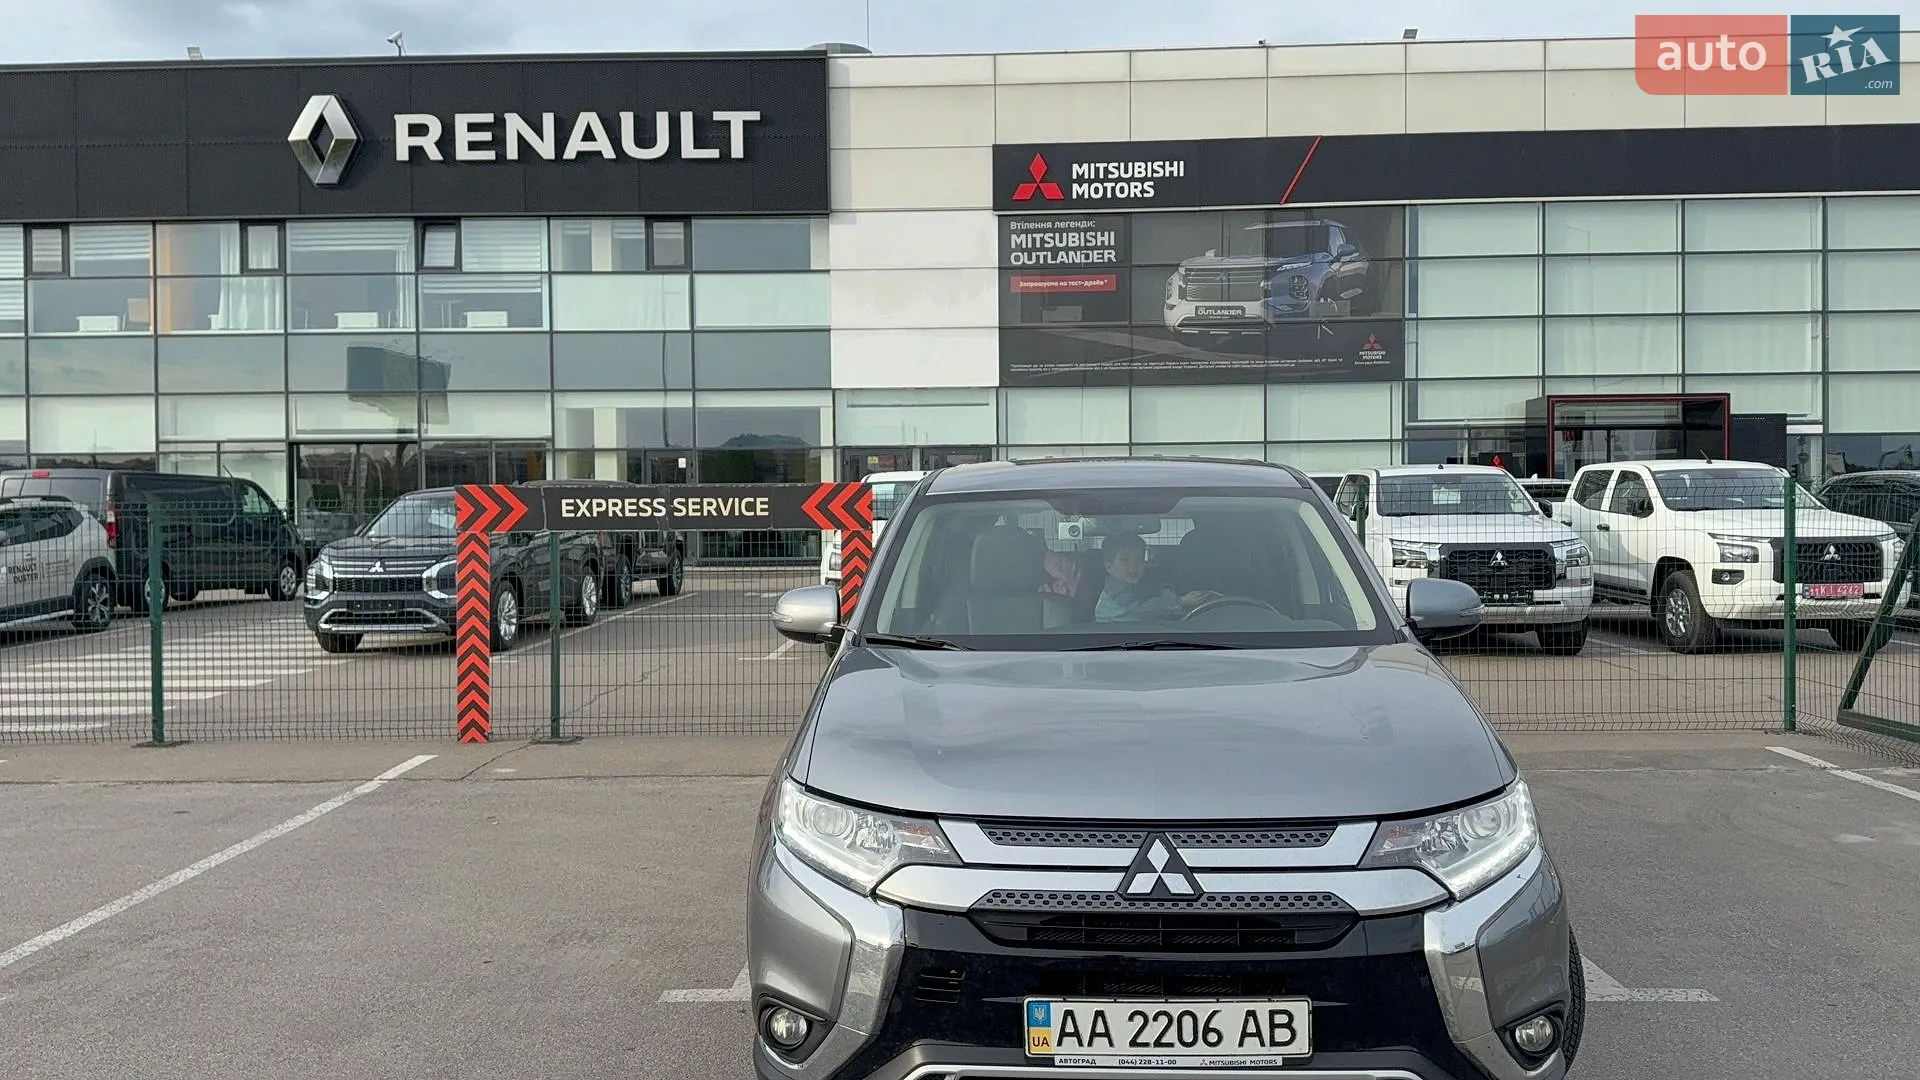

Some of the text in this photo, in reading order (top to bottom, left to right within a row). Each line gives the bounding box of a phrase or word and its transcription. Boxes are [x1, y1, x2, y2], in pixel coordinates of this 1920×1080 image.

[394, 111, 761, 161] RENAULT
[1072, 160, 1185, 179] MITSUBISHI
[1072, 181, 1155, 199] MOTORS
[1010, 220, 1096, 230] Втілення легенди:
[1010, 231, 1115, 249] MITSUBISHI
[1010, 249, 1117, 265] OUTLANDER
[561, 497, 769, 518] EXPRESS SERVICE
[1056, 1009, 1297, 1048] AA 2206 AB
[1032, 1036, 1050, 1048] UA
[1058, 1058, 1097, 1066] АВТОГРАД
[1118, 1058, 1177, 1066] (044) 228-11-00
[1249, 1058, 1278, 1066] MOTORS
